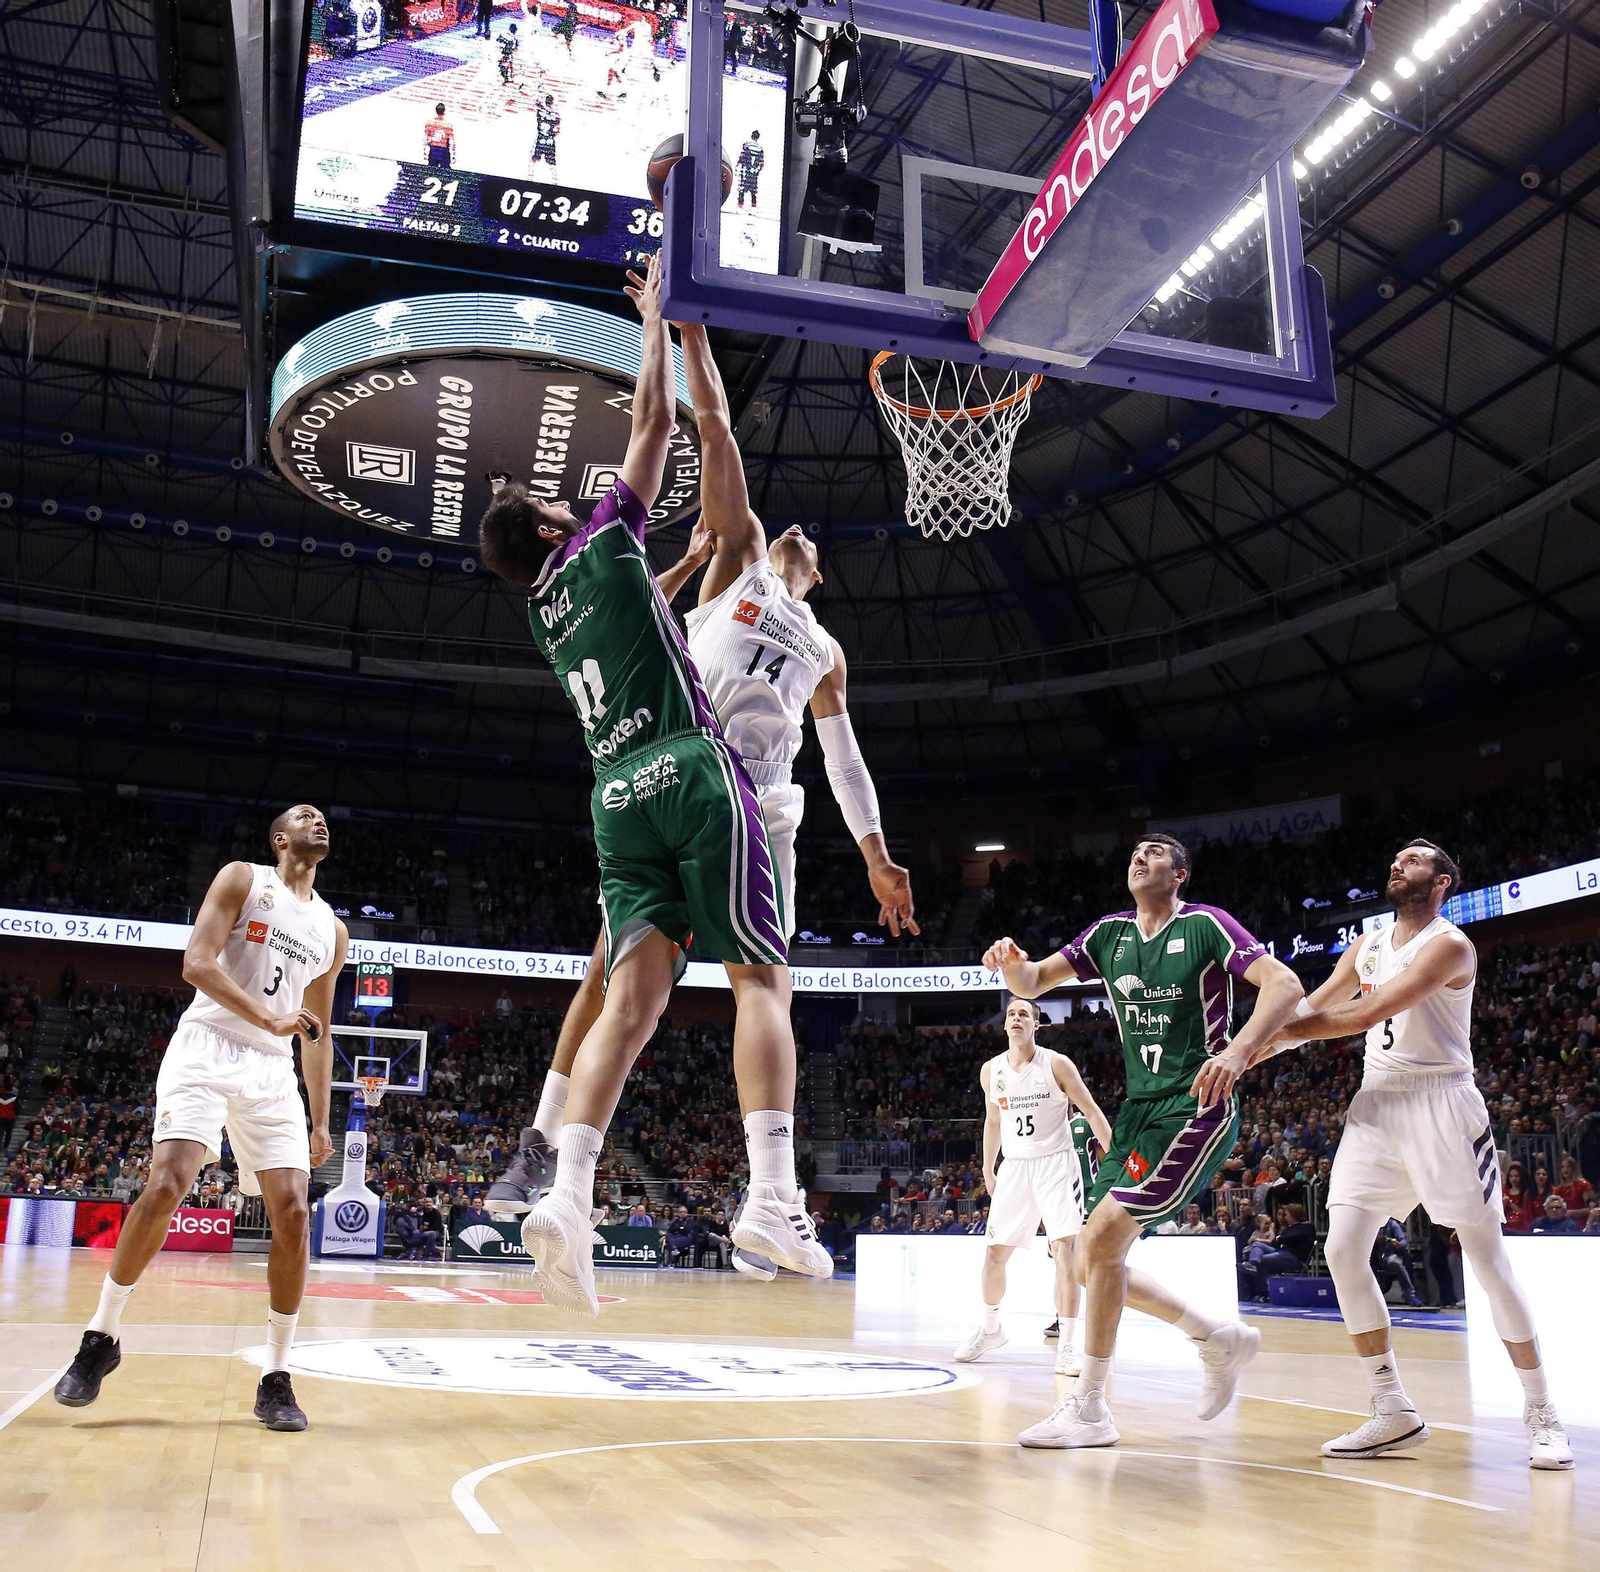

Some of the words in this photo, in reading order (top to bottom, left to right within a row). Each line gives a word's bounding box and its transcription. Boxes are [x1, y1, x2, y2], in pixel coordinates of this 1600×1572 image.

[1022, 11, 1189, 262] endesa
[419, 177, 460, 206] 21
[500, 188, 590, 227] 07:34
[403, 217, 449, 234] FALTAS
[451, 224, 462, 236] 2
[627, 209, 664, 238] 36
[522, 234, 580, 253] CUARTO
[301, 370, 418, 429] PORTICO
[436, 376, 474, 450] GRUPO
[532, 385, 580, 474] RESERVA
[434, 454, 467, 476] LA
[292, 454, 415, 532] VELAZQUEZ
[529, 479, 562, 498] LA
[430, 479, 465, 537] RESERVA
[539, 586, 573, 629] DÍEZ
[759, 622, 805, 659] Europea
[764, 611, 821, 662] Universidad
[746, 644, 787, 685] 14
[632, 775, 655, 793] DEL
[654, 764, 679, 781] SOL
[1576, 871, 1598, 891] La
[65, 919, 109, 939] 93.4
[115, 924, 143, 942] FM
[1337, 925, 1358, 946] 36
[268, 938, 307, 965] Europea
[272, 927, 321, 965] Universidad
[362, 963, 393, 976] 07:34
[380, 947, 409, 964] del
[415, 949, 519, 974] Baloncesto,
[526, 957, 565, 974] 93.4
[263, 966, 283, 996] 3
[363, 978, 390, 997] 13
[819, 972, 847, 988] del
[853, 972, 955, 988] Baloncesto,
[960, 971, 1000, 987] 93.4
[1144, 983, 1183, 998] Unicaja
[1125, 1004, 1172, 1033] Málaga
[1140, 1044, 1163, 1074] 17
[1009, 1092, 1050, 1102] Universidad
[1010, 1101, 1039, 1109] Europea
[1016, 1115, 1035, 1136] 25
[325, 1235, 350, 1243] Málaga
[604, 1244, 657, 1261] Unicaja
